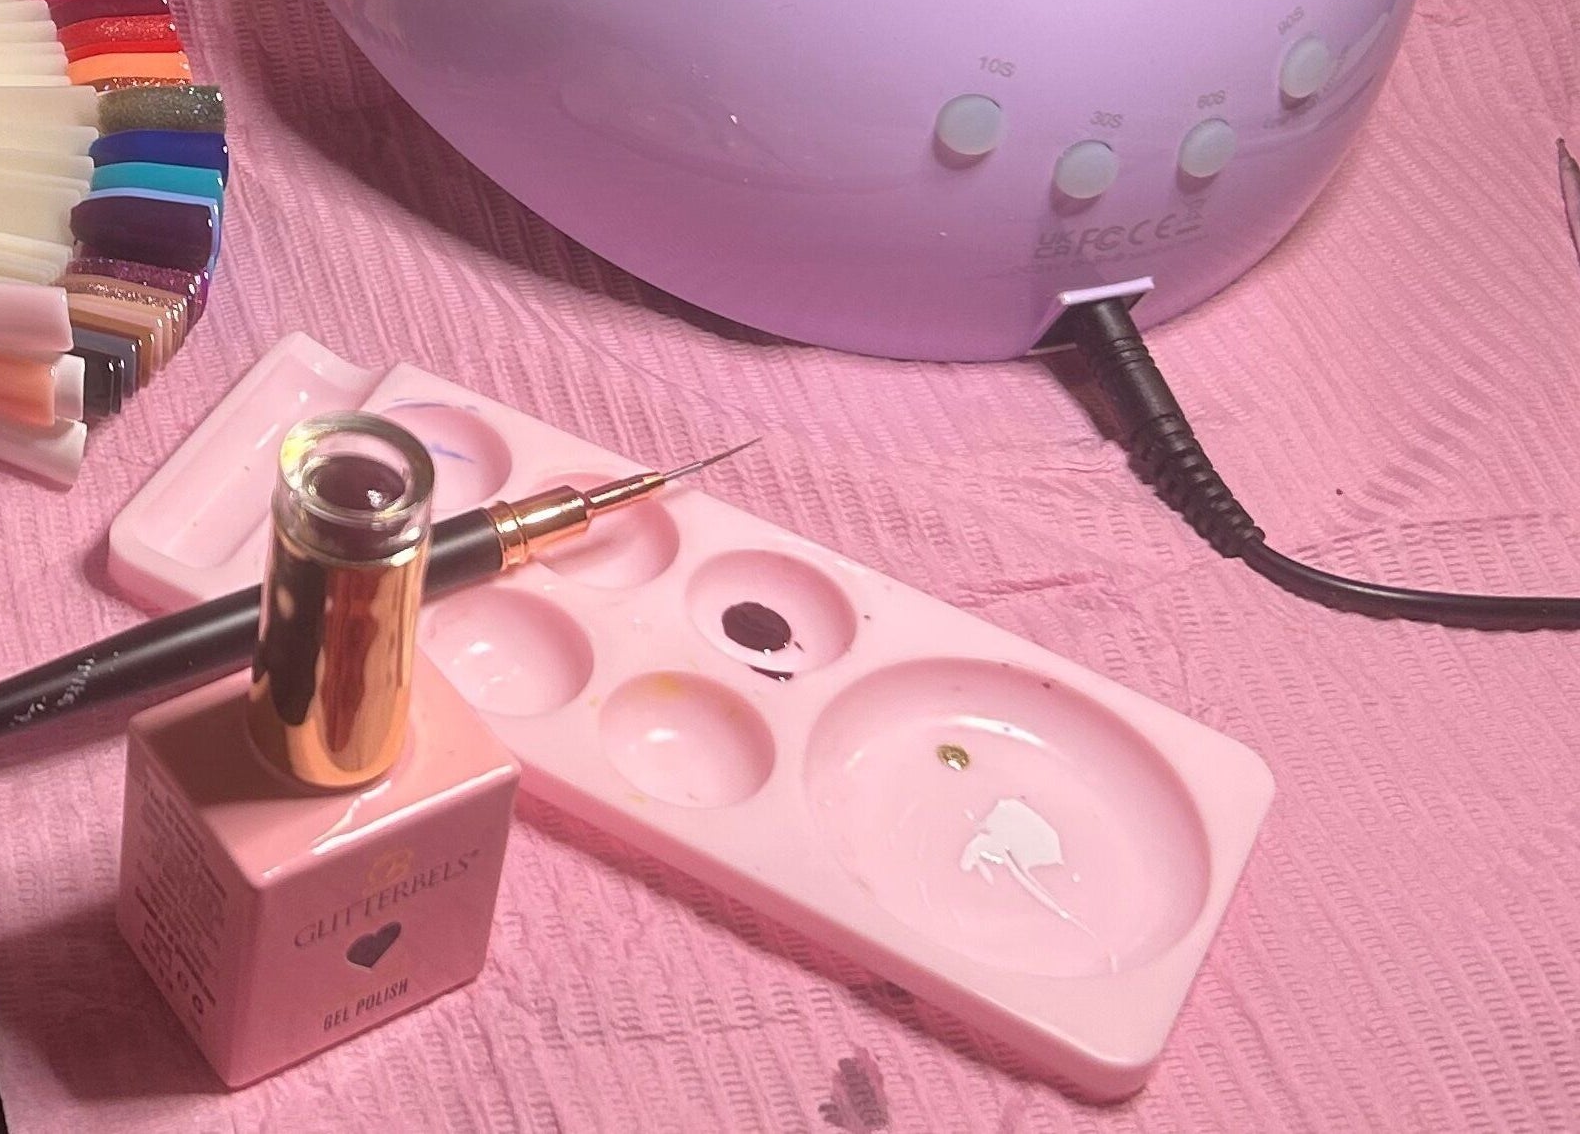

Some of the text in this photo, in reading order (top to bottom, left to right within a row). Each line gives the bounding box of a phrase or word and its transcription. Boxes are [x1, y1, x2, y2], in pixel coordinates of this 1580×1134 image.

[977, 55, 1017, 79] 10S
[1088, 109, 1124, 130] 30S
[292, 855, 471, 949] GLITTERBELS
[322, 978, 409, 1033] GEL POLISH
